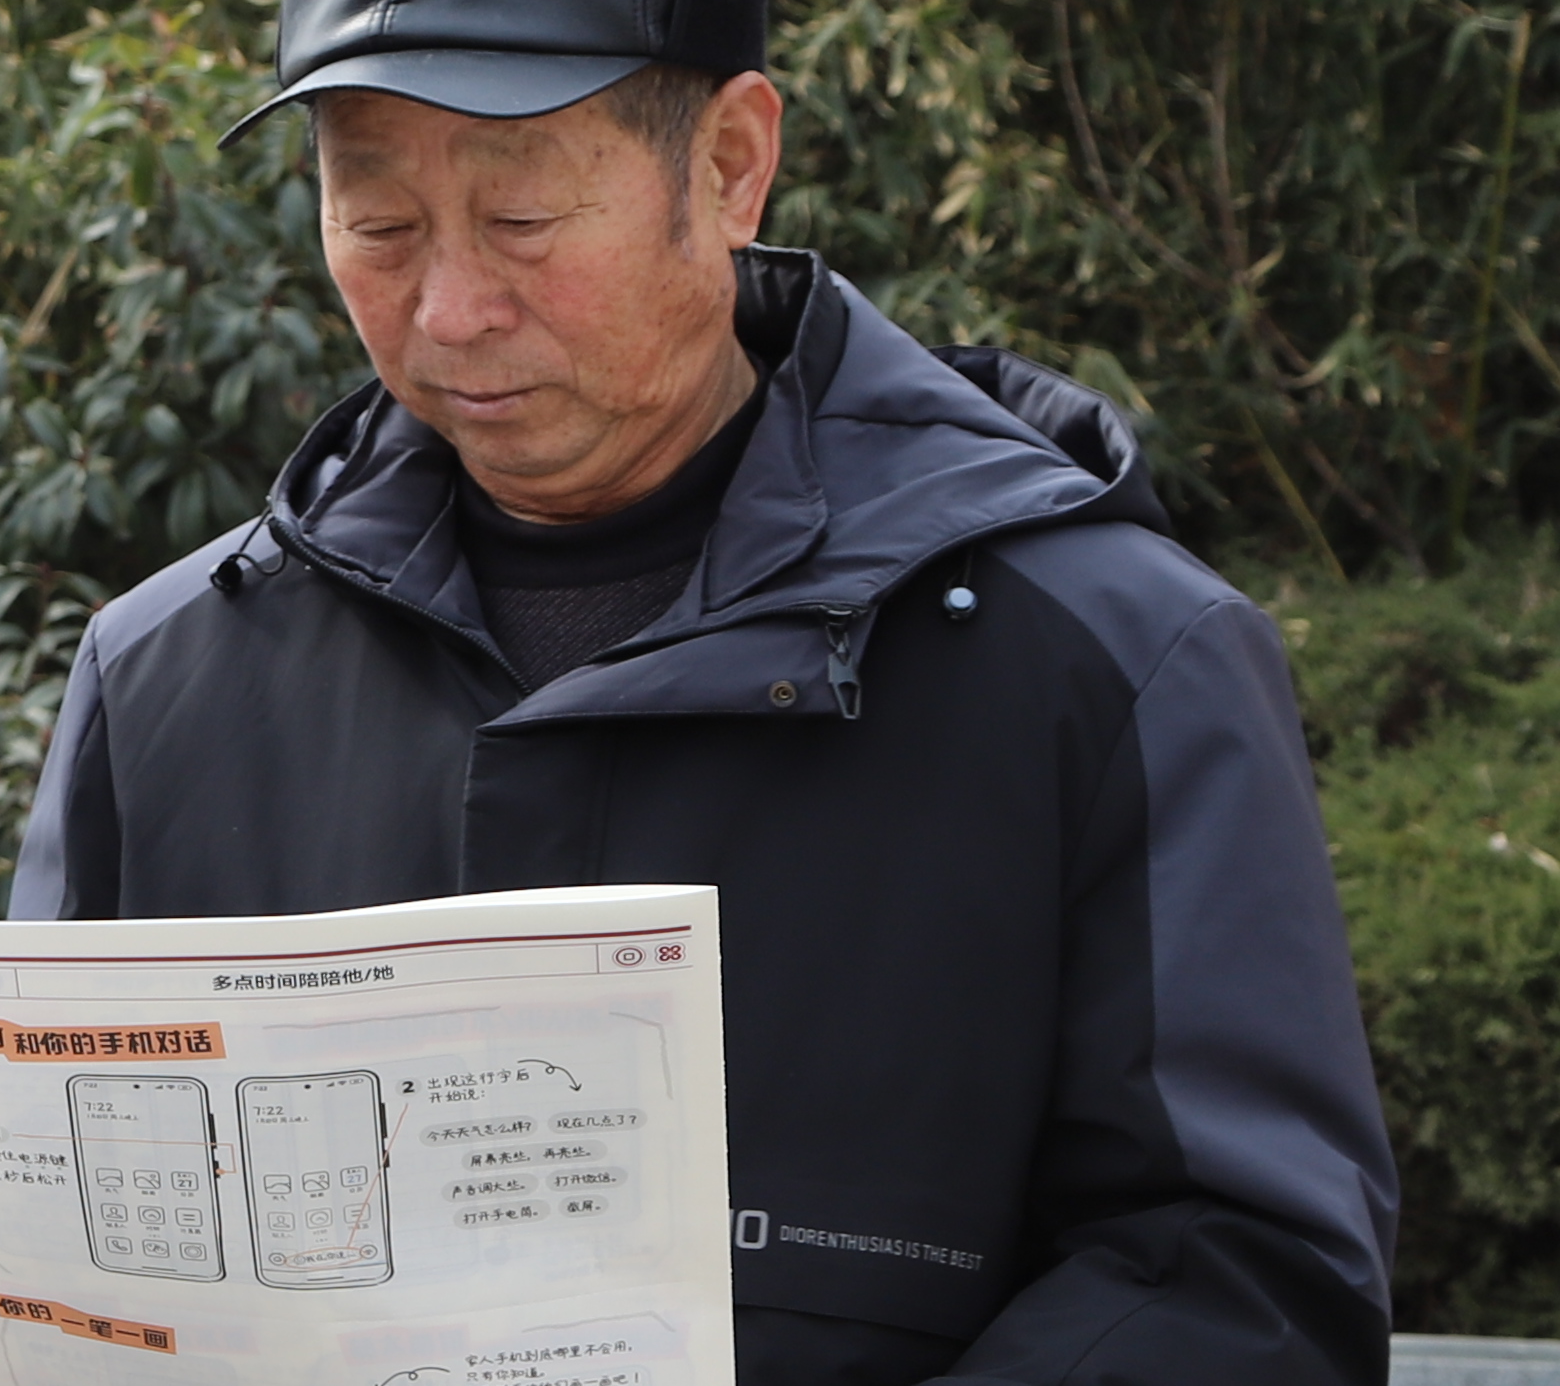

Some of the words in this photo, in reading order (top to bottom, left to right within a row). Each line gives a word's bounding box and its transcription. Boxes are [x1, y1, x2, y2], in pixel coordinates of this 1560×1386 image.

[212, 965, 394, 991] 多点时间陪陪他/她
[14, 1029, 213, 1055] 和你的手机对话
[402, 1081, 415, 1094] 2
[427, 1069, 530, 1090] 出现这行字后
[83, 1101, 114, 1112] 7:22
[253, 1106, 284, 1116] 7:22
[178, 1179, 193, 1188] 27
[779, 1225, 904, 1256] DIORENTHUSIAS
[905, 1241, 921, 1259] IS
[921, 1244, 949, 1264] THE
[950, 1250, 984, 1271] BEST
[60, 1317, 169, 1349] 一笔一画
[466, 1369, 545, 1382] 只有你知道。
